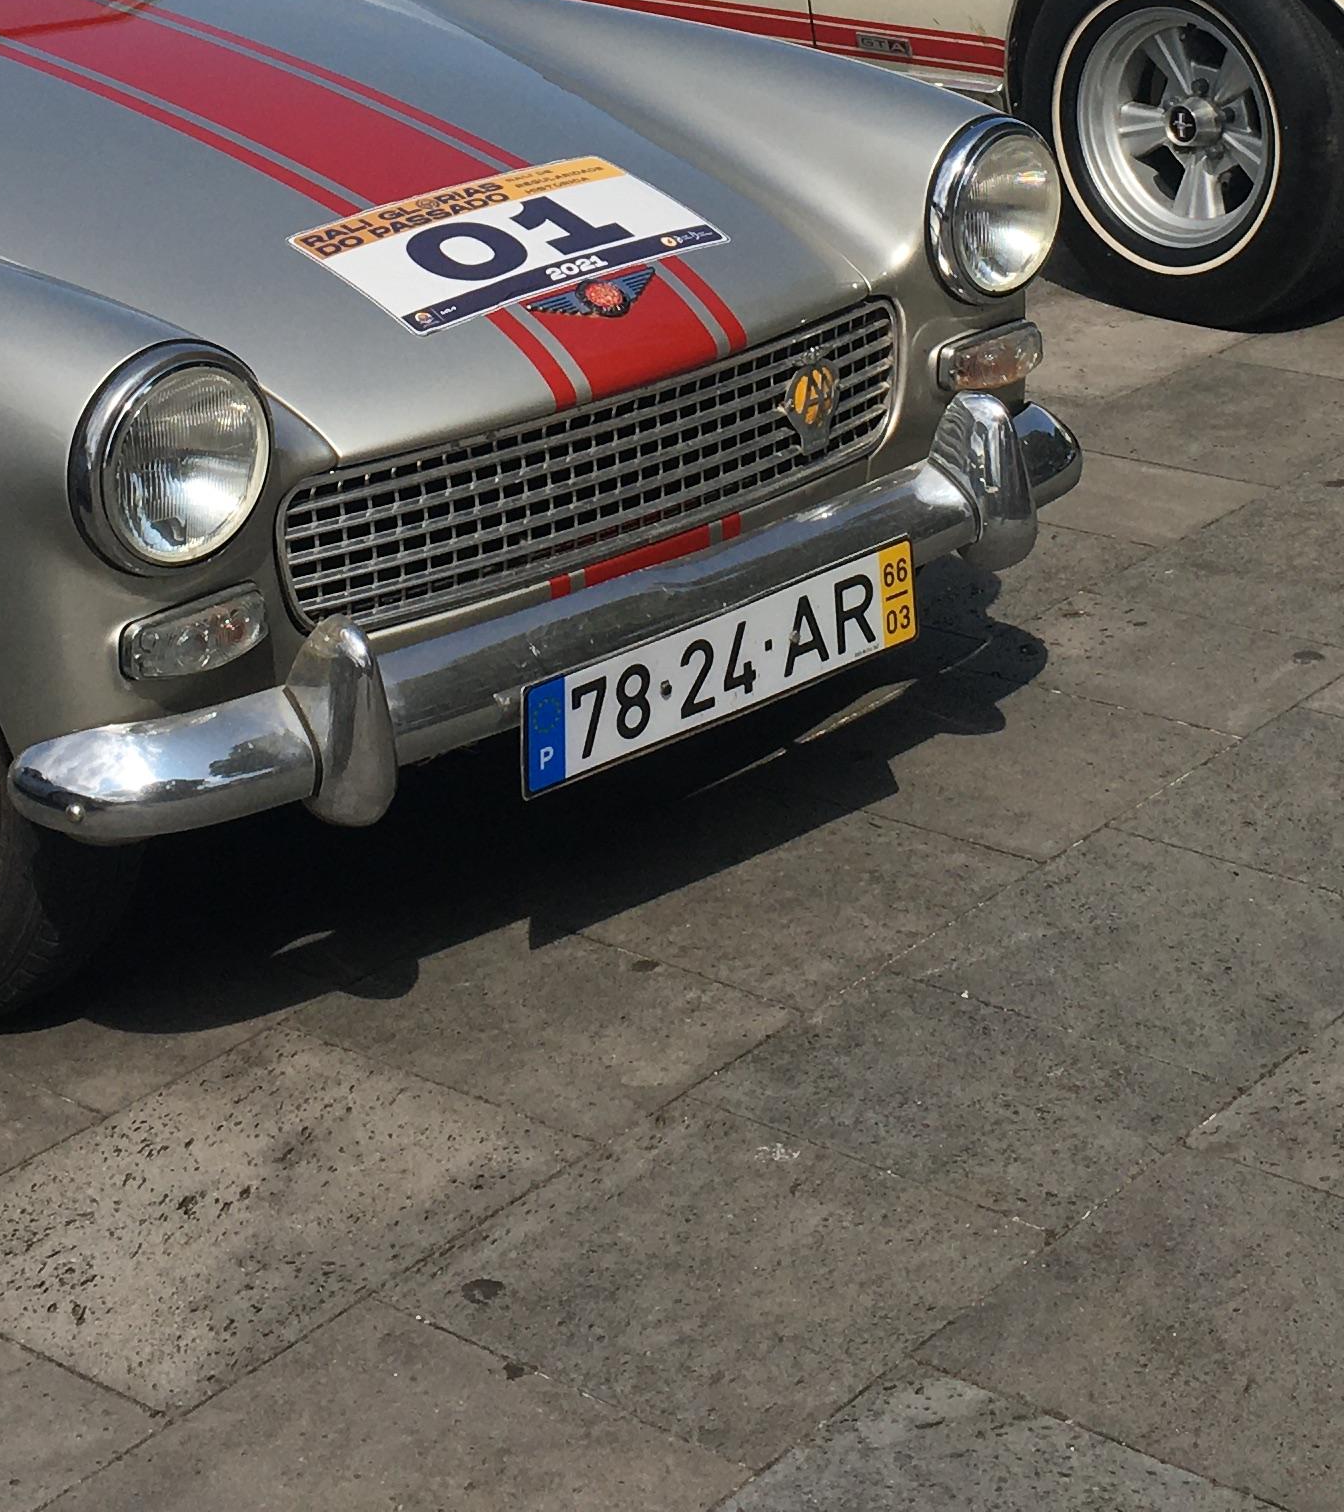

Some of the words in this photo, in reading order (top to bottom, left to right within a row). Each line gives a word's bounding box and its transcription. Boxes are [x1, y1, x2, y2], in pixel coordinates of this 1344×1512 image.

[300, 219, 374, 248] RALI
[317, 235, 365, 257] DO
[368, 193, 510, 238] PASSADO
[406, 195, 635, 281] 01
[545, 255, 608, 281] 2021
[883, 558, 908, 587] 66
[886, 605, 911, 634] 03
[539, 746, 554, 771] P
